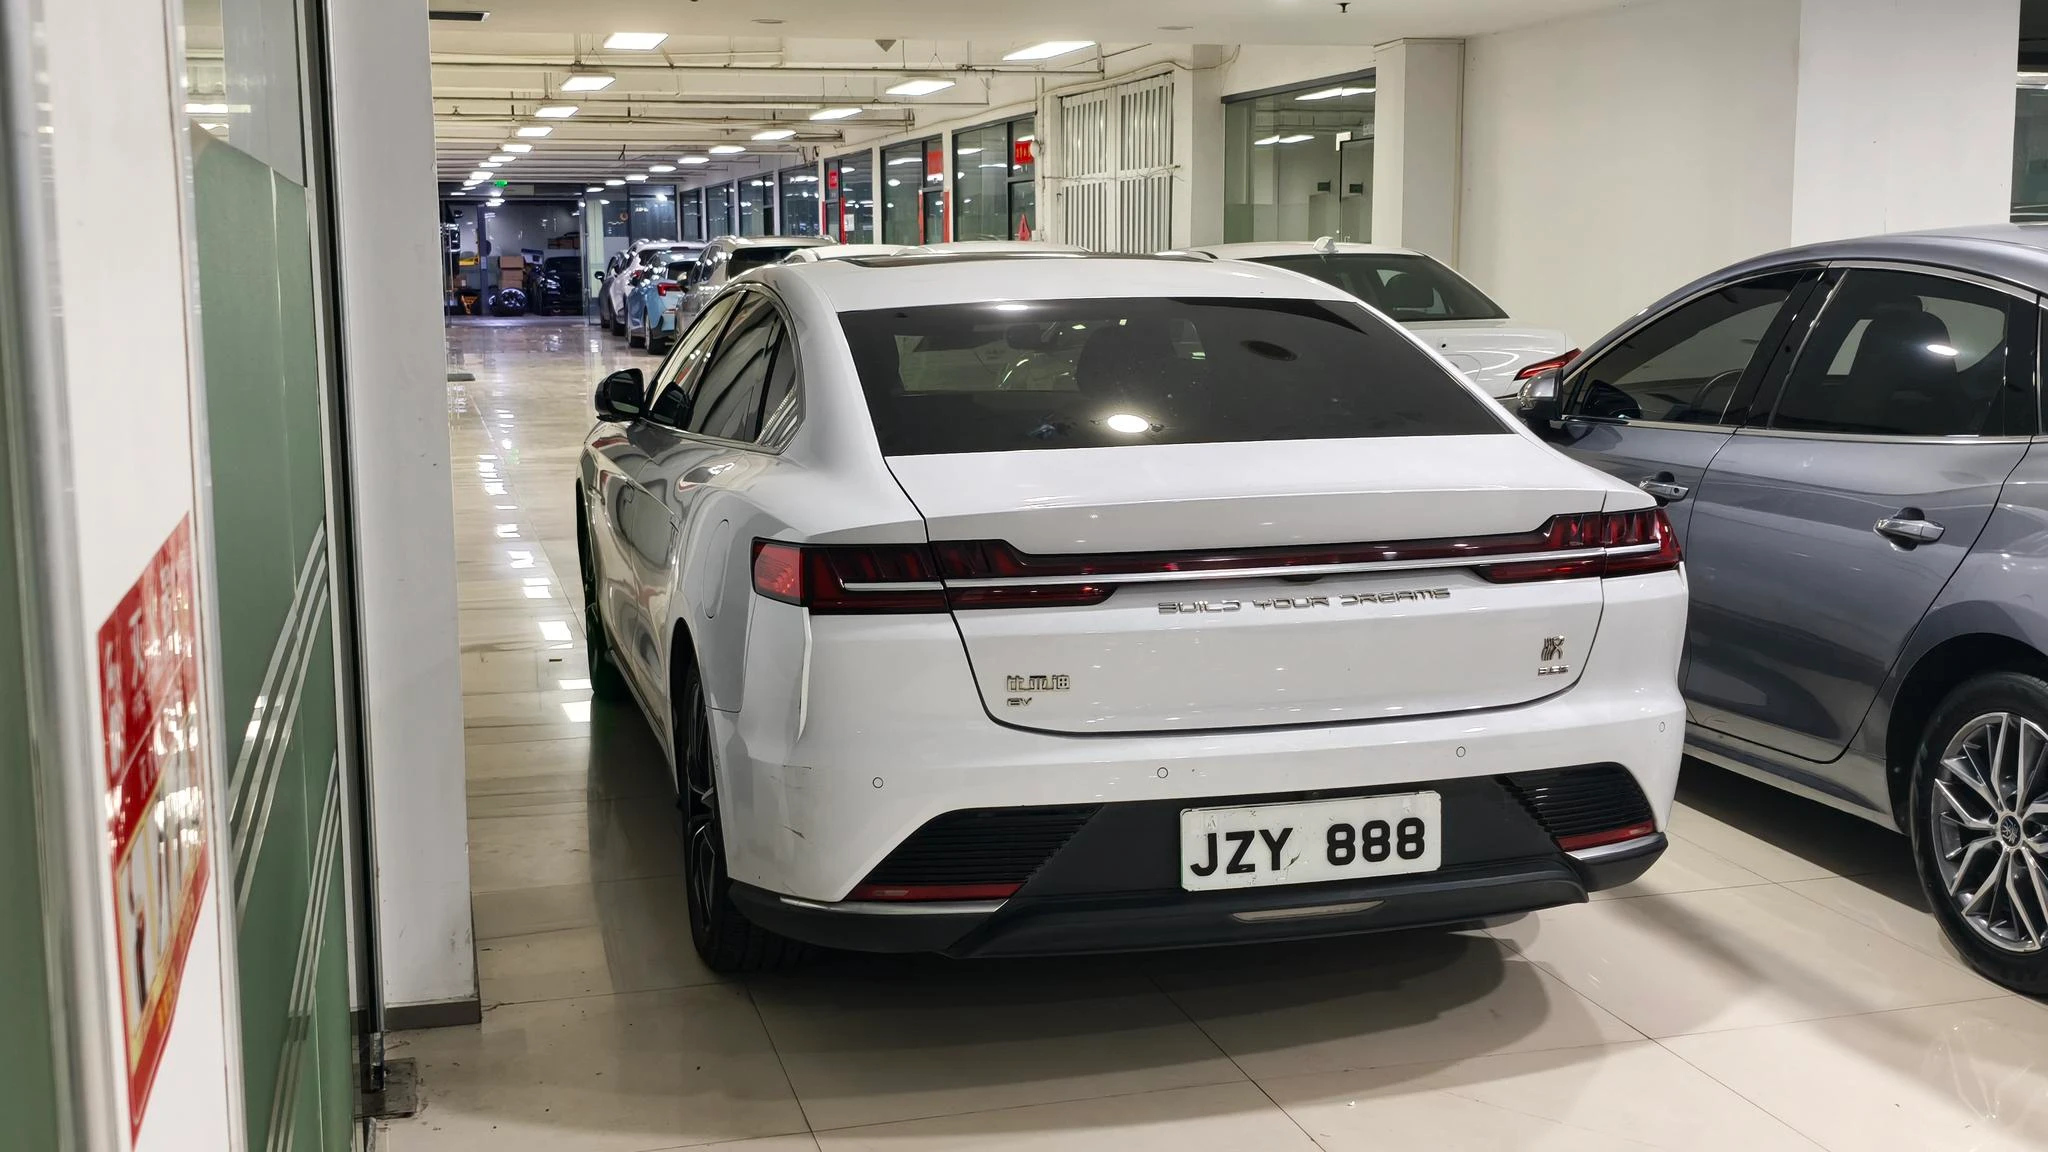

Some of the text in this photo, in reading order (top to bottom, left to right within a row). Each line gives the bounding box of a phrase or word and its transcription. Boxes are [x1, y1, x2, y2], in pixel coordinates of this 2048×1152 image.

[1158, 587, 1451, 614] BUILD YOUR DREAMS
[1007, 697, 1032, 707] EV
[1190, 817, 1427, 877] JZY 888
